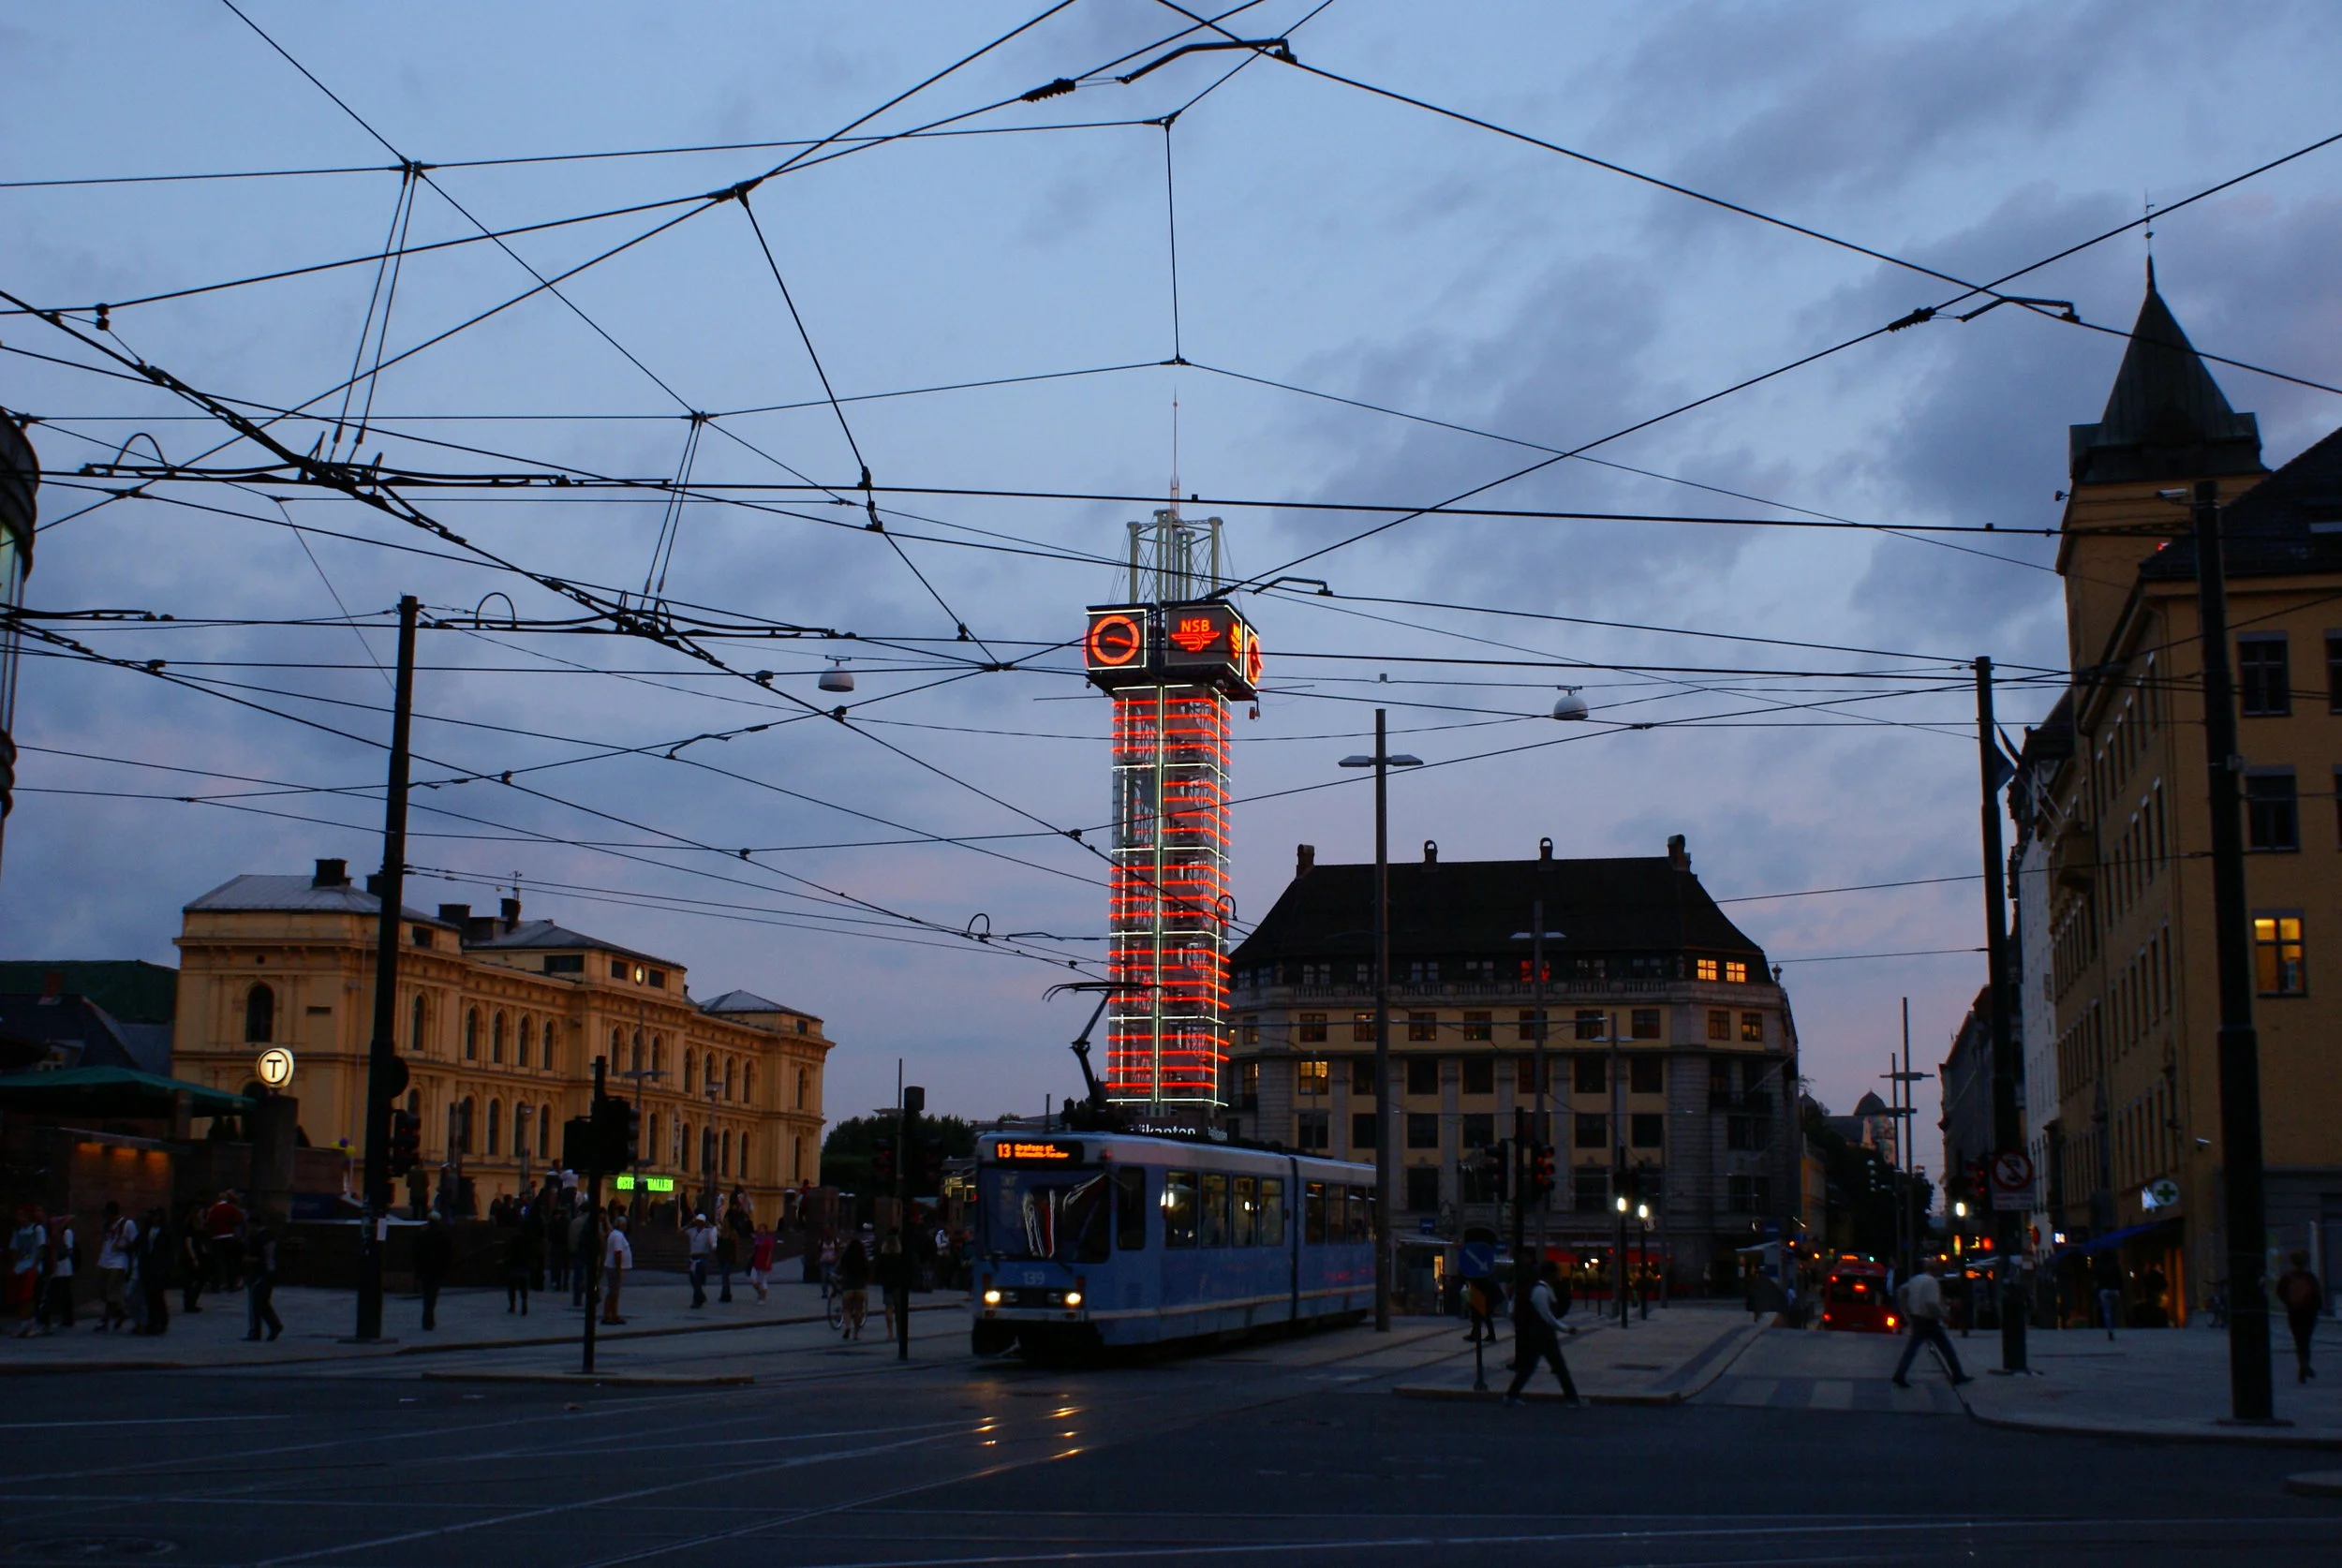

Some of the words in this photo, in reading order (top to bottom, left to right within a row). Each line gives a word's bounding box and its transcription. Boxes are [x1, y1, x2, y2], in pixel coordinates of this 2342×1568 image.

[1180, 619, 1210, 633] NSB
[267, 1059, 282, 1078] T
[998, 1143, 1012, 1158] 13
[1023, 1270, 1045, 1285] 139
